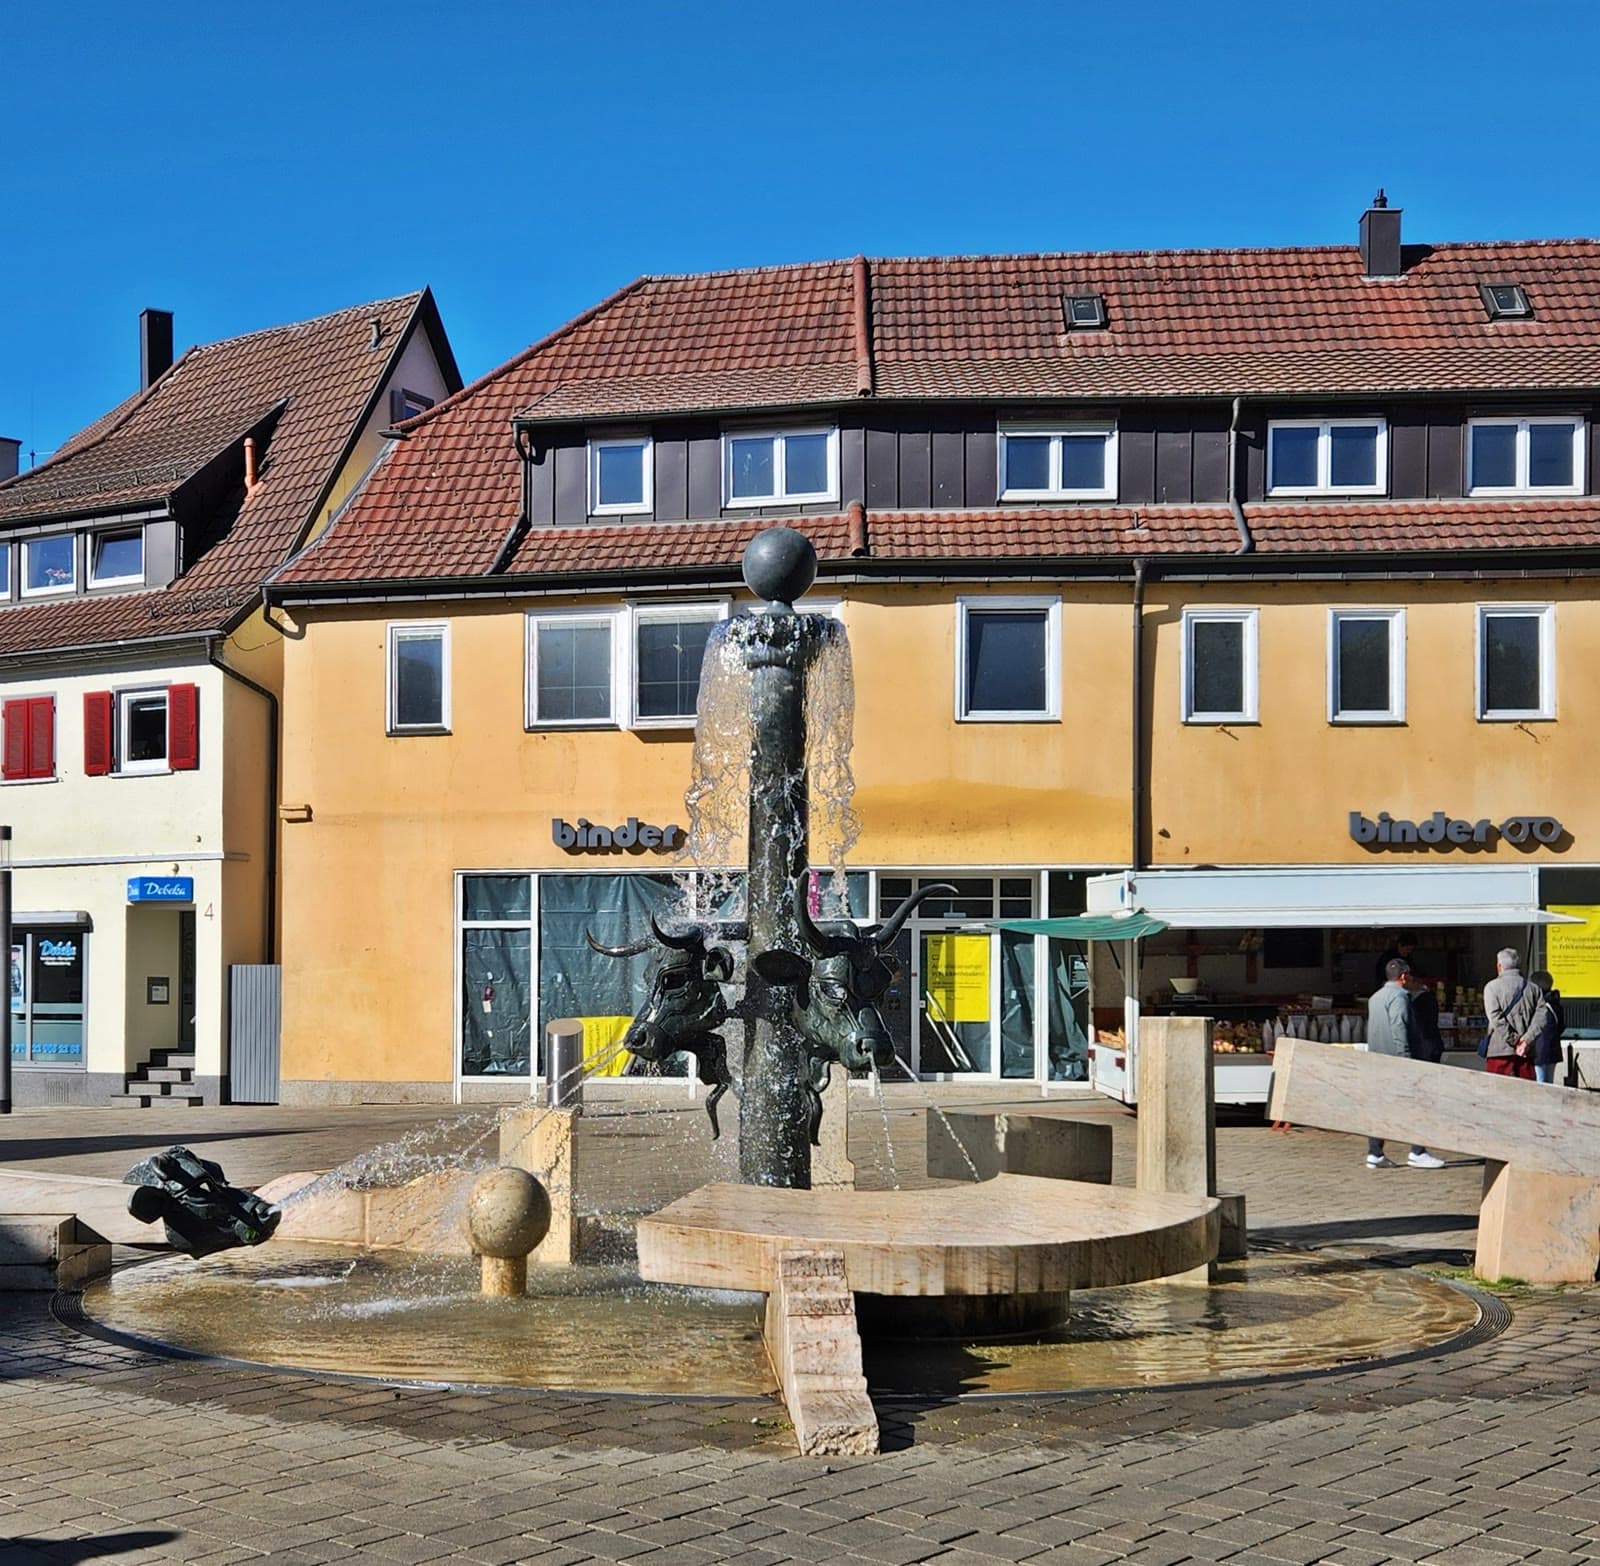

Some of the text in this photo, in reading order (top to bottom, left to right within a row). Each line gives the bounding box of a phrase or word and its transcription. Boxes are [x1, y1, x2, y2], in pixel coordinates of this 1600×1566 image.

[551, 817, 679, 848] binder
[1349, 811, 1491, 843] binder
[144, 881, 186, 896] Debeka
[204, 902, 215, 921] 4
